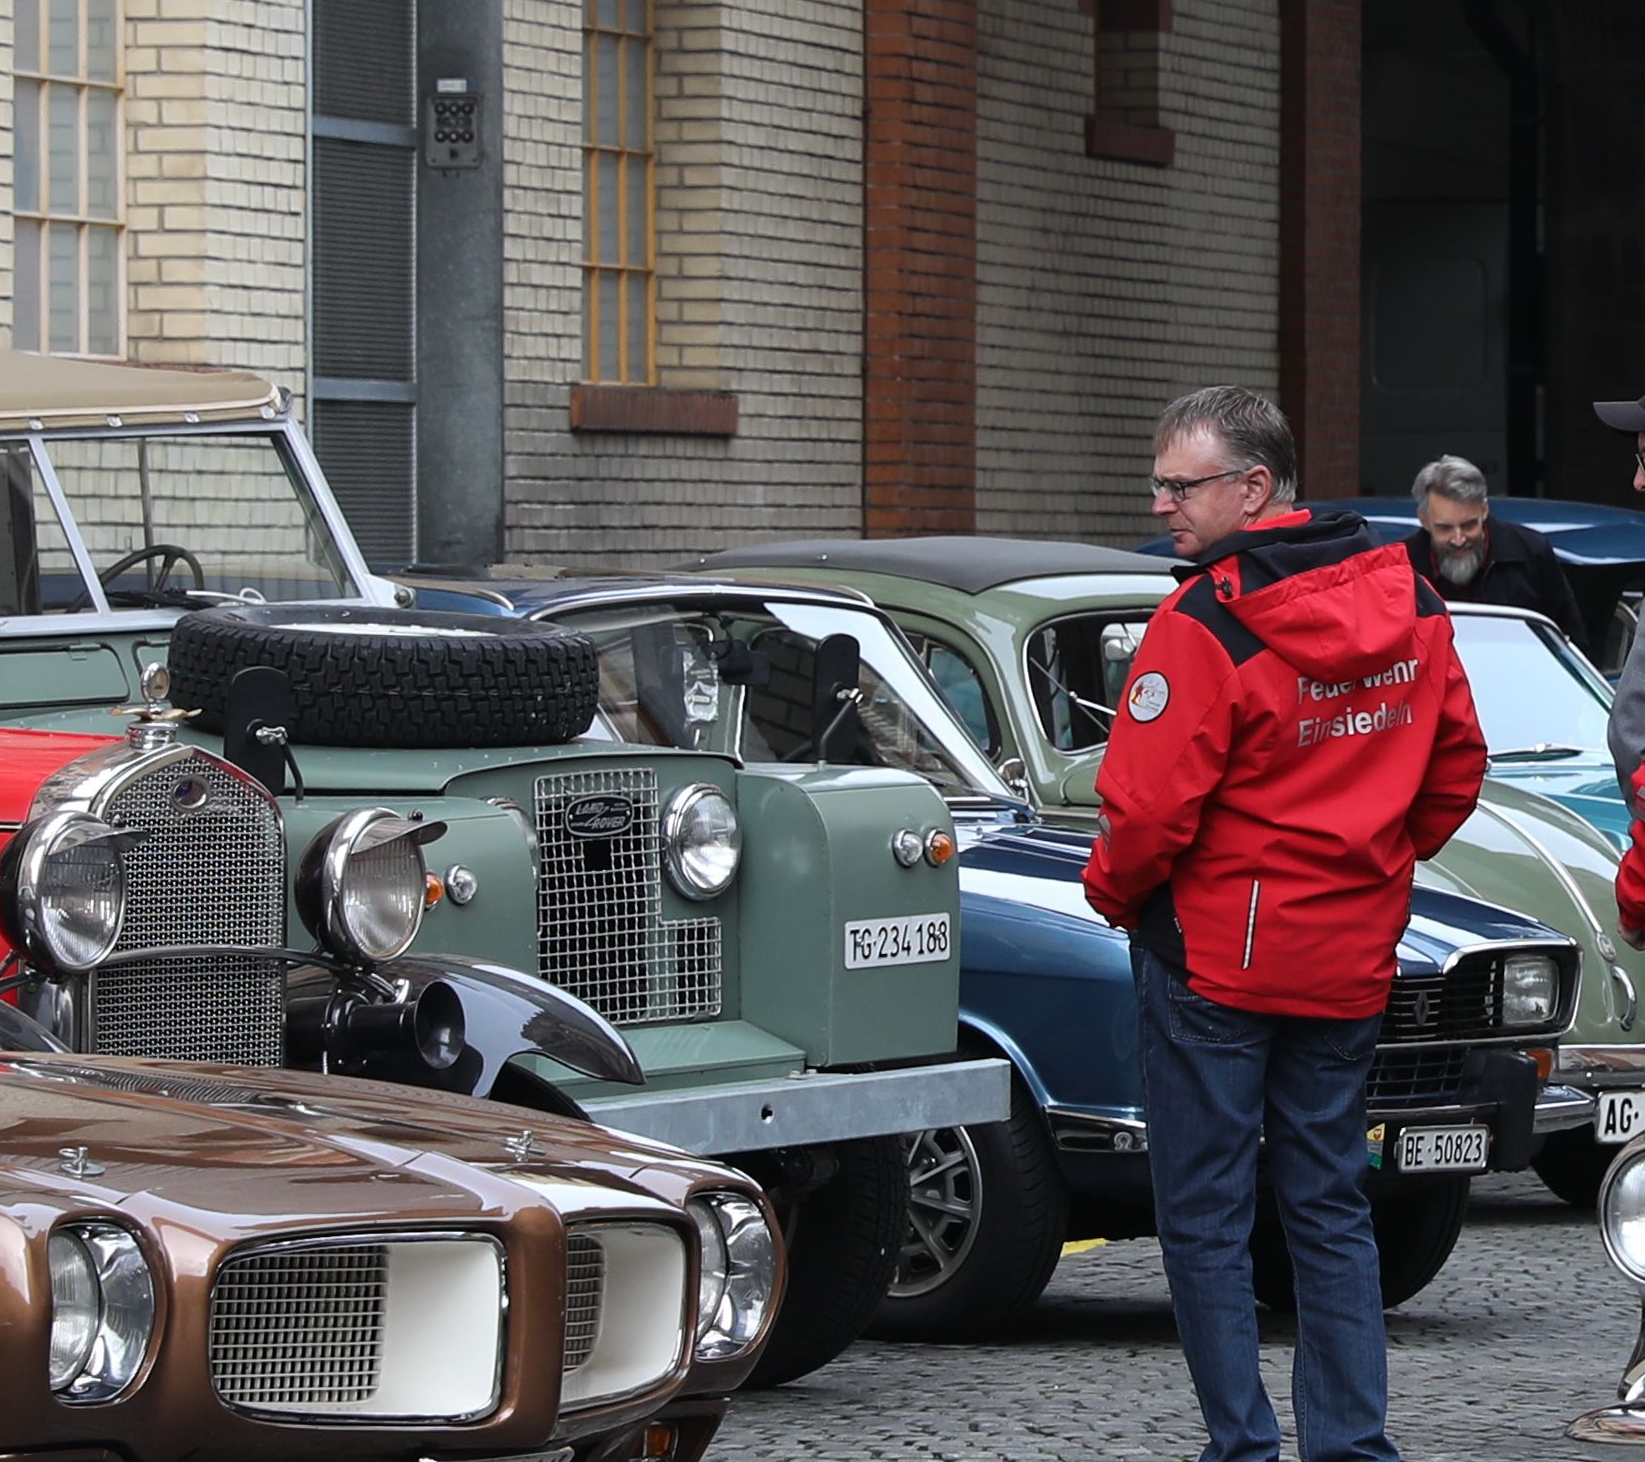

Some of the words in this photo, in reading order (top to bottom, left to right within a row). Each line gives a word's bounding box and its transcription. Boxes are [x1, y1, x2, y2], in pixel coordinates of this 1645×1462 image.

[1297, 658, 1418, 704] Feuewehr
[1297, 700, 1413, 747] Einsiedeln
[575, 802, 604, 815] LAND
[591, 816, 626, 829] ROVER
